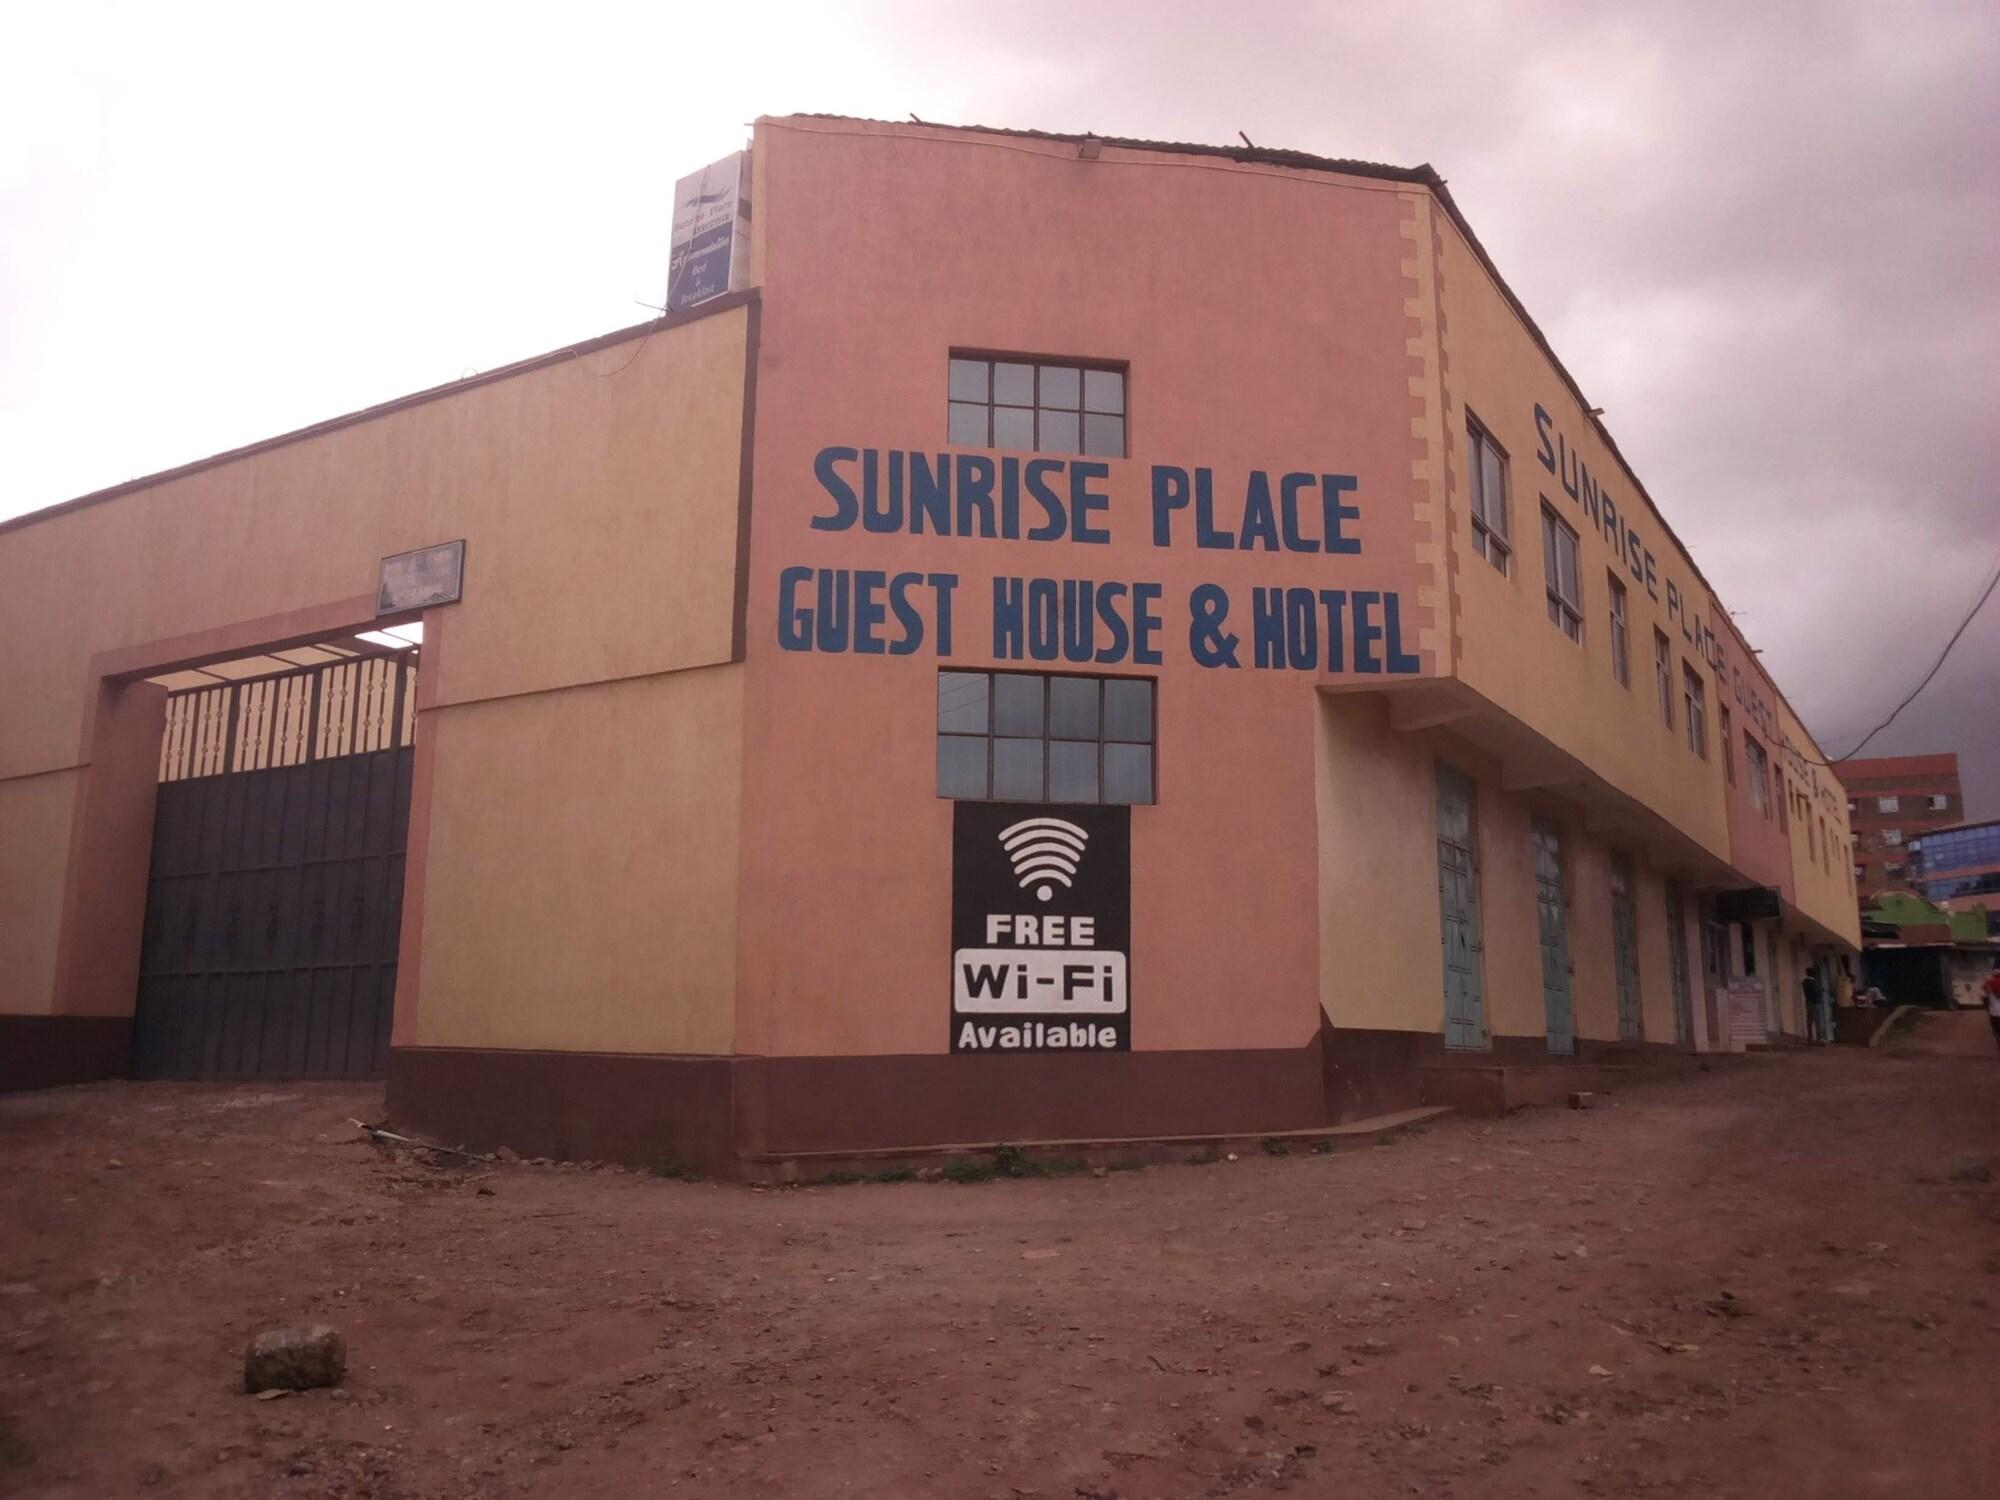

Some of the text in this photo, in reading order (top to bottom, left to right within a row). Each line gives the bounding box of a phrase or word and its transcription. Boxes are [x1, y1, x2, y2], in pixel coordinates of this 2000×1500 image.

[810, 446, 1362, 555] SUNRISE PLACE
[1534, 402, 1659, 603] SUNRISE
[1666, 577, 1727, 686] PLACE
[777, 566, 1420, 674] GUEST HOUSE & HOTEL
[986, 914, 1095, 946] FREE
[962, 963, 1113, 1002] Wi-Fi
[958, 1021, 1117, 1049] Available
